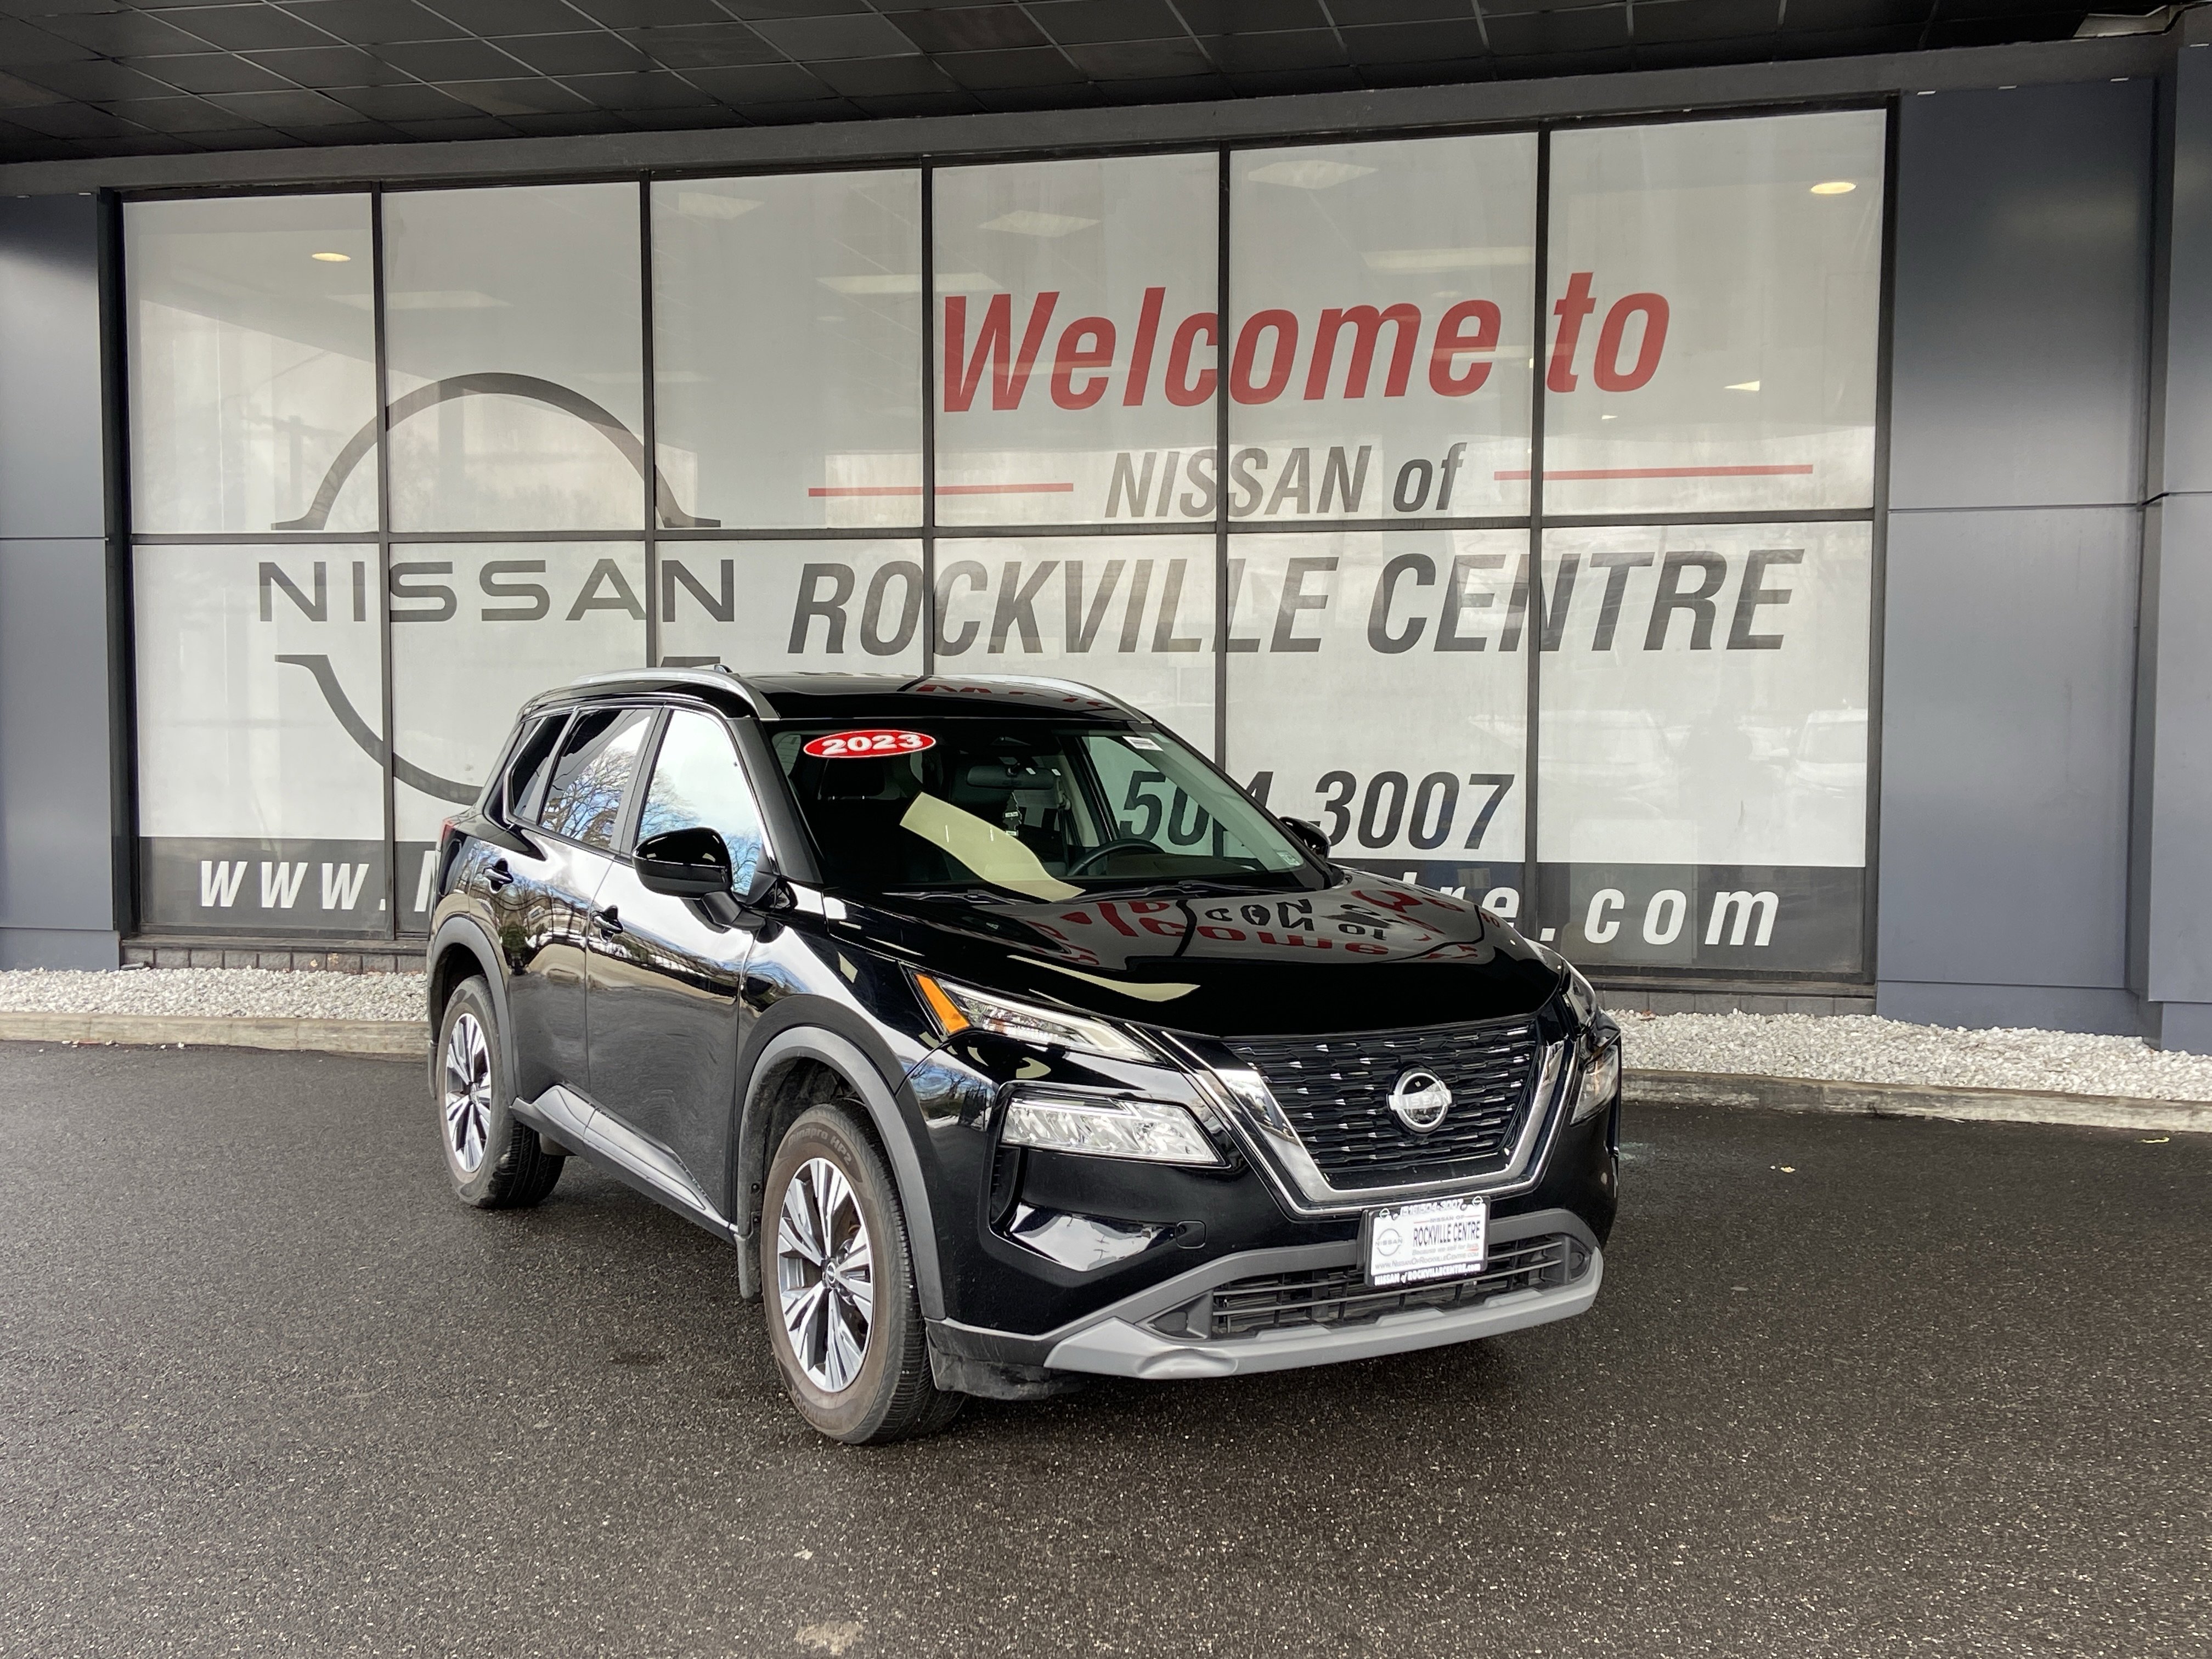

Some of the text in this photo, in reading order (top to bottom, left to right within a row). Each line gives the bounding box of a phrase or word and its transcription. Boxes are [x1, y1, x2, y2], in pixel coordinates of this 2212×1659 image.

[945, 272, 1670, 413] Welcome to
[1105, 442, 1468, 518] NISSAN of
[259, 558, 734, 622] NISSAN
[787, 549, 1805, 656] ROCKVILLE CENTRE
[822, 734, 923, 755] 2023
[1392, 1088, 1452, 1108] NISSAN
[830, 1136, 851, 1165] HP2
[1375, 1238, 1403, 1246] NISSAN
[1413, 1220, 1480, 1247] ROCKVILLE CENTRE
[1374, 1273, 1400, 1286] NISSAN
